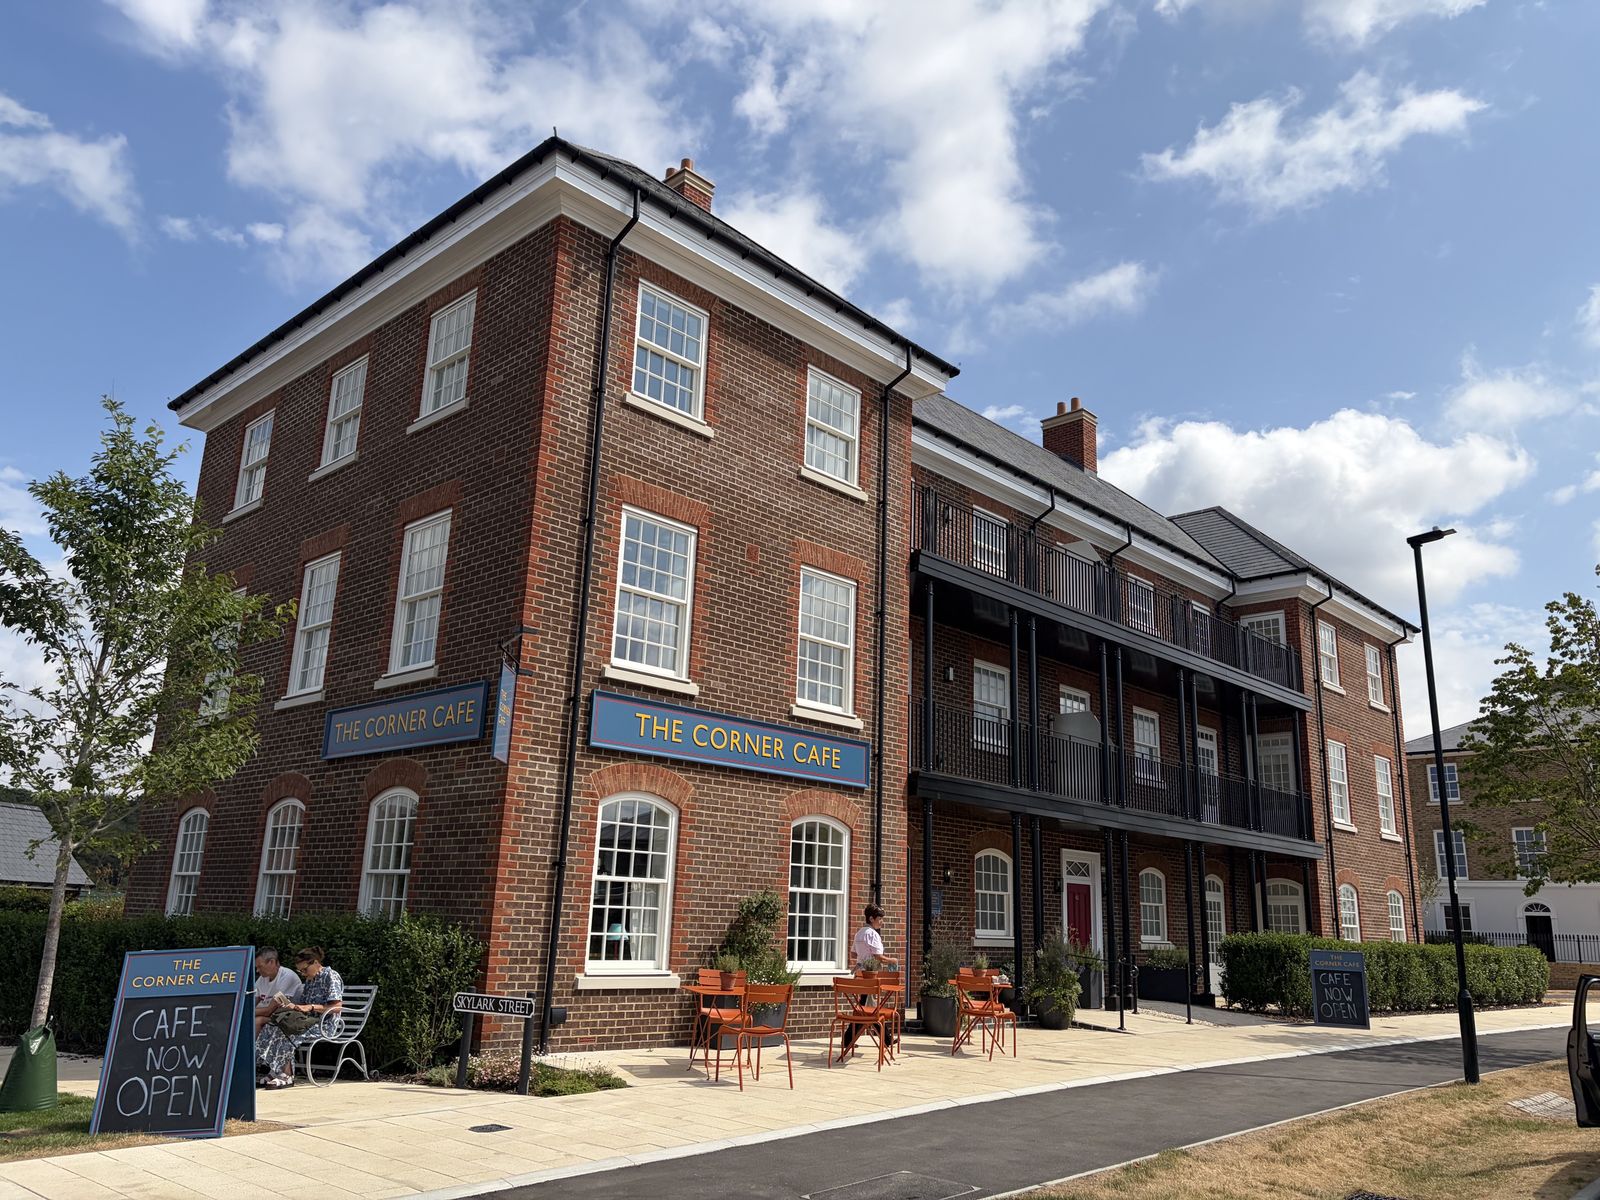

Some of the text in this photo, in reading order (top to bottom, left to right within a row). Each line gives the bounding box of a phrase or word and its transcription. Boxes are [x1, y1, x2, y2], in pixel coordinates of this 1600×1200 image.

[335, 720, 361, 743] THE
[364, 708, 427, 738] CORNER
[432, 700, 475, 727] CAFE
[635, 712, 841, 769] THE CORNER CAFE
[173, 959, 202, 971] THE
[132, 971, 237, 988] CORNER CAFE
[1320, 973, 1351, 985] CAFE
[1324, 987, 1353, 1002] NOW
[456, 995, 531, 1014] SKYLARK STREET
[1320, 1002, 1358, 1019] OPEN
[132, 1005, 213, 1042] CAFE
[146, 1043, 211, 1072] NOW
[116, 1075, 212, 1118] OPEN
